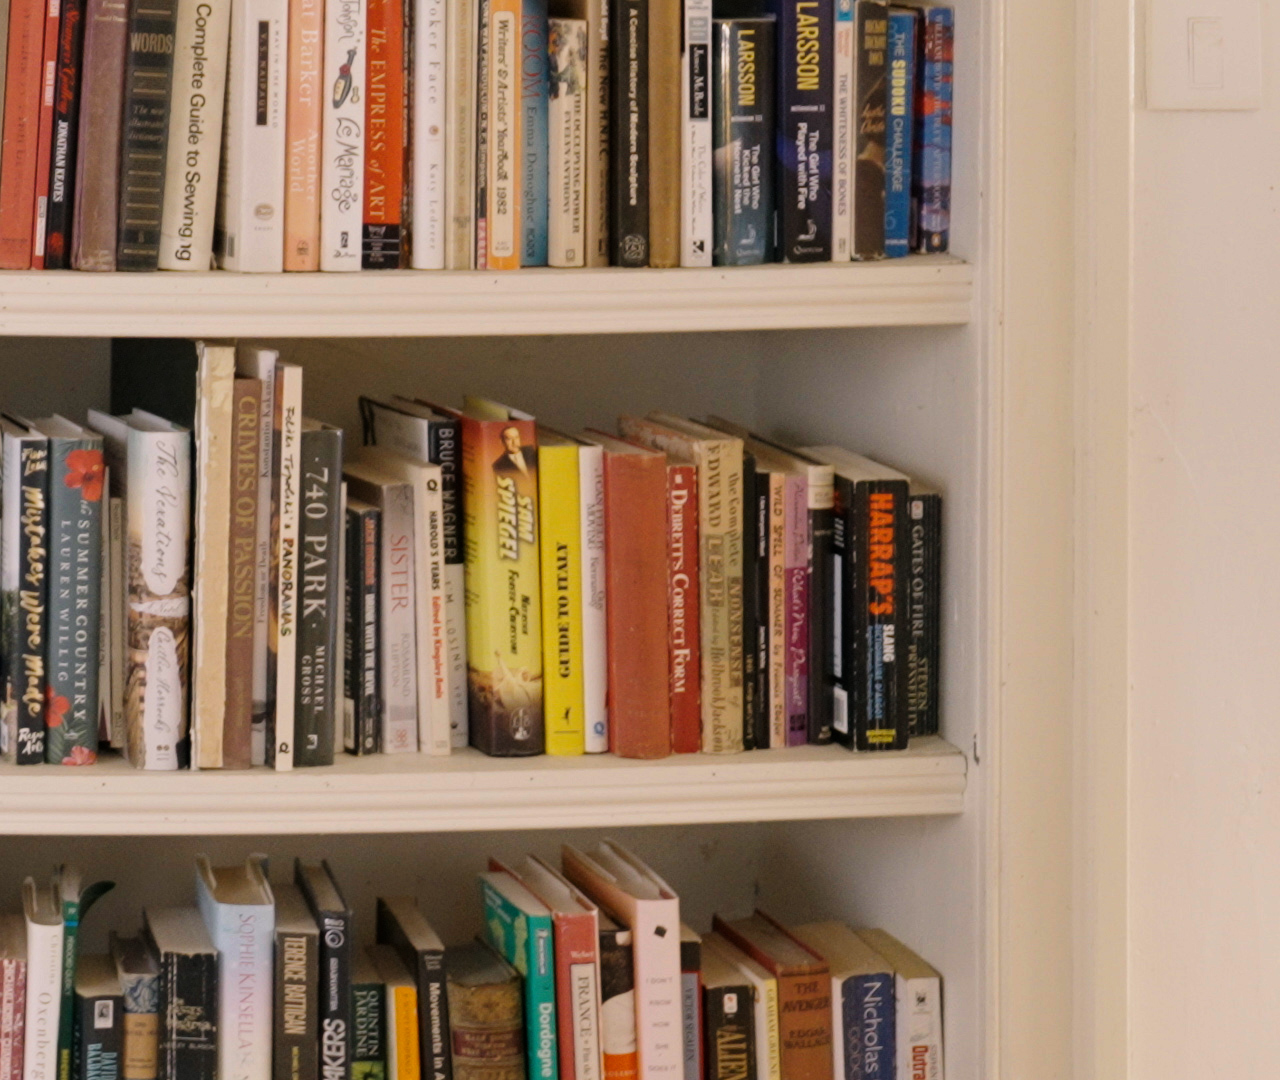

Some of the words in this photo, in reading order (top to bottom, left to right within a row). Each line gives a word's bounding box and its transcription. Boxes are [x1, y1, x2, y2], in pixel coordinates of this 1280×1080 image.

[131, 33, 173, 54] WORDS
[191, 3, 212, 90] Complete
[370, 27, 386, 53] The
[629, 18, 638, 59] Concise
[796, 1, 819, 90] LARSSON
[895, 32, 904, 56] THE
[298, 29, 319, 108] Barker
[428, 61, 440, 105] Face
[627, 61, 638, 98] History
[737, 29, 755, 105] LARSSON
[891, 59, 906, 116] SUDOKU
[188, 93, 206, 145] Guide
[370, 60, 386, 152] EMPRESS
[526, 106, 537, 148] Emma
[629, 101, 638, 111] of
[55, 120, 68, 167] JONATHAN
[629, 113, 638, 152] Modern
[751, 145, 761, 163] The
[796, 122, 808, 159] Played
[891, 118, 903, 192] CHALLENGE
[52, 168, 66, 202] KEATES
[186, 151, 200, 168] to
[290, 139, 305, 193] World
[306, 128, 318, 203] Another
[368, 159, 386, 176] of
[627, 154, 637, 205] Sculpture
[751, 166, 761, 182] Girl
[797, 161, 808, 184] with
[178, 170, 201, 238] Sewing
[368, 180, 386, 220] ART
[524, 152, 538, 222] Donoghue
[751, 185, 760, 210] Who
[797, 187, 807, 209] Fire
[237, 396, 258, 491] CRIMES
[79, 499, 92, 514] the
[304, 467, 328, 520] 740
[707, 444, 720, 528] EDWARD
[22, 486, 45, 587] Mistakes
[235, 497, 256, 528] OF
[429, 511, 440, 558] HAROLD'S
[497, 476, 518, 560] SPIEGEL
[517, 494, 533, 542] SAM
[671, 488, 688, 570] DEBRETT'S
[59, 520, 71, 598] LAUREN
[75, 519, 89, 609] SUMMER
[390, 533, 408, 615] SISTER
[556, 542, 569, 592] ITALY
[706, 539, 724, 605] LEAR
[869, 493, 894, 616] HARRAP'S
[911, 525, 924, 574] GATES
[233, 537, 254, 639] PASSION
[303, 534, 328, 618] PARK
[431, 561, 441, 591] YEARS
[911, 578, 924, 599] OF
[20, 591, 44, 649] Were
[431, 626, 441, 637] by
[432, 596, 441, 623] Edited
[557, 597, 569, 619] TO
[672, 573, 690, 645] CORRECT
[911, 604, 924, 638] FIRE
[57, 608, 69, 682] WILLIG
[73, 615, 88, 721] COUNTRY
[401, 633, 411, 697] ROSAMUND
[432, 639, 443, 676] Kingsley
[558, 625, 570, 678] GUIDE
[882, 624, 895, 662] SLANG
[21, 655, 44, 717] Made
[302, 655, 312, 706] GROSS
[313, 644, 326, 714] MICHAEL
[434, 677, 443, 699] Amis
[673, 648, 690, 693] FORM
[239, 914, 256, 967] SOPHIE
[284, 937, 307, 981] TERENCE
[238, 973, 255, 1049] KINSELLA
[284, 984, 306, 1035] RATTIGAN
[354, 990, 368, 1057] JARDINE
[368, 990, 379, 1056] QUINTIN
[429, 982, 442, 1054] Movements
[685, 987, 695, 1021] VICTOR
[767, 989, 777, 1032] GRAHAM
[863, 981, 883, 1074] Nicholas
[434, 1057, 445, 1068] in
[537, 1002, 553, 1077] Dordogne
[686, 1023, 695, 1061] SEGALEN
[768, 1035, 779, 1077] GREENE
